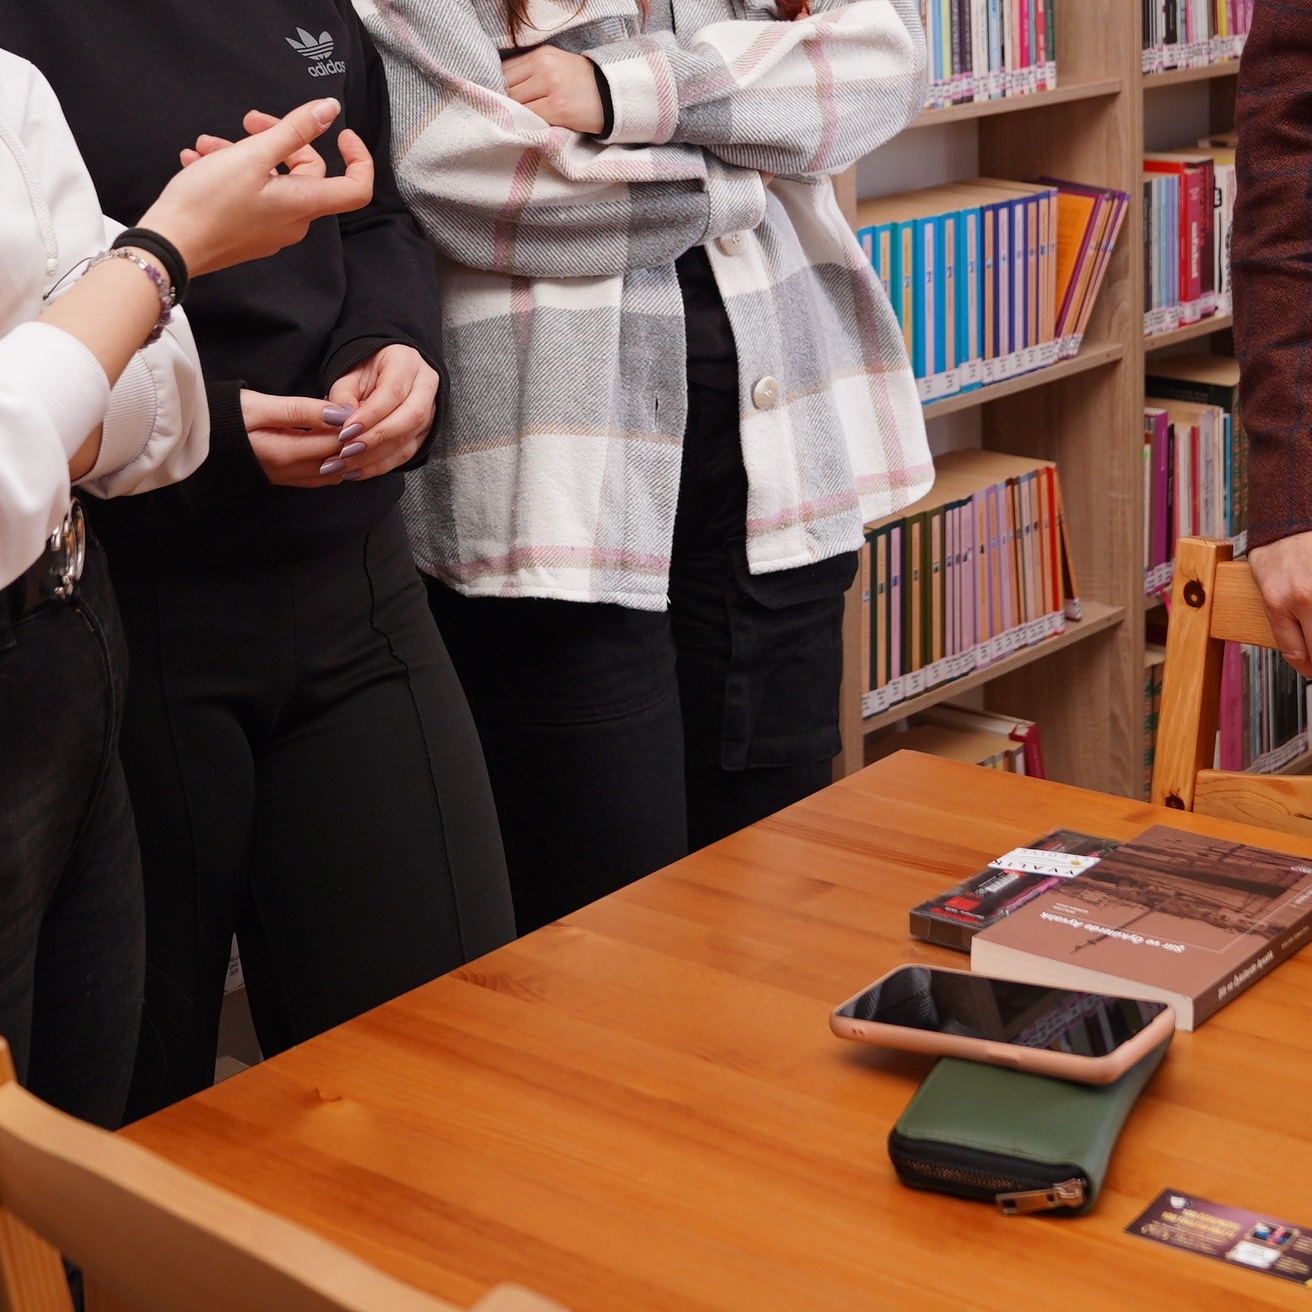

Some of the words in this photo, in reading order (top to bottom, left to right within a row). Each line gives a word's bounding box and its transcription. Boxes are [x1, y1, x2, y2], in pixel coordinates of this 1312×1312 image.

[308, 59, 346, 77] adidas
[1039, 911, 1084, 928] Ayvalık
[1083, 922, 1145, 945] Öykülerde
[1145, 938, 1161, 948] ve
[1161, 942, 1186, 954] Şiir
